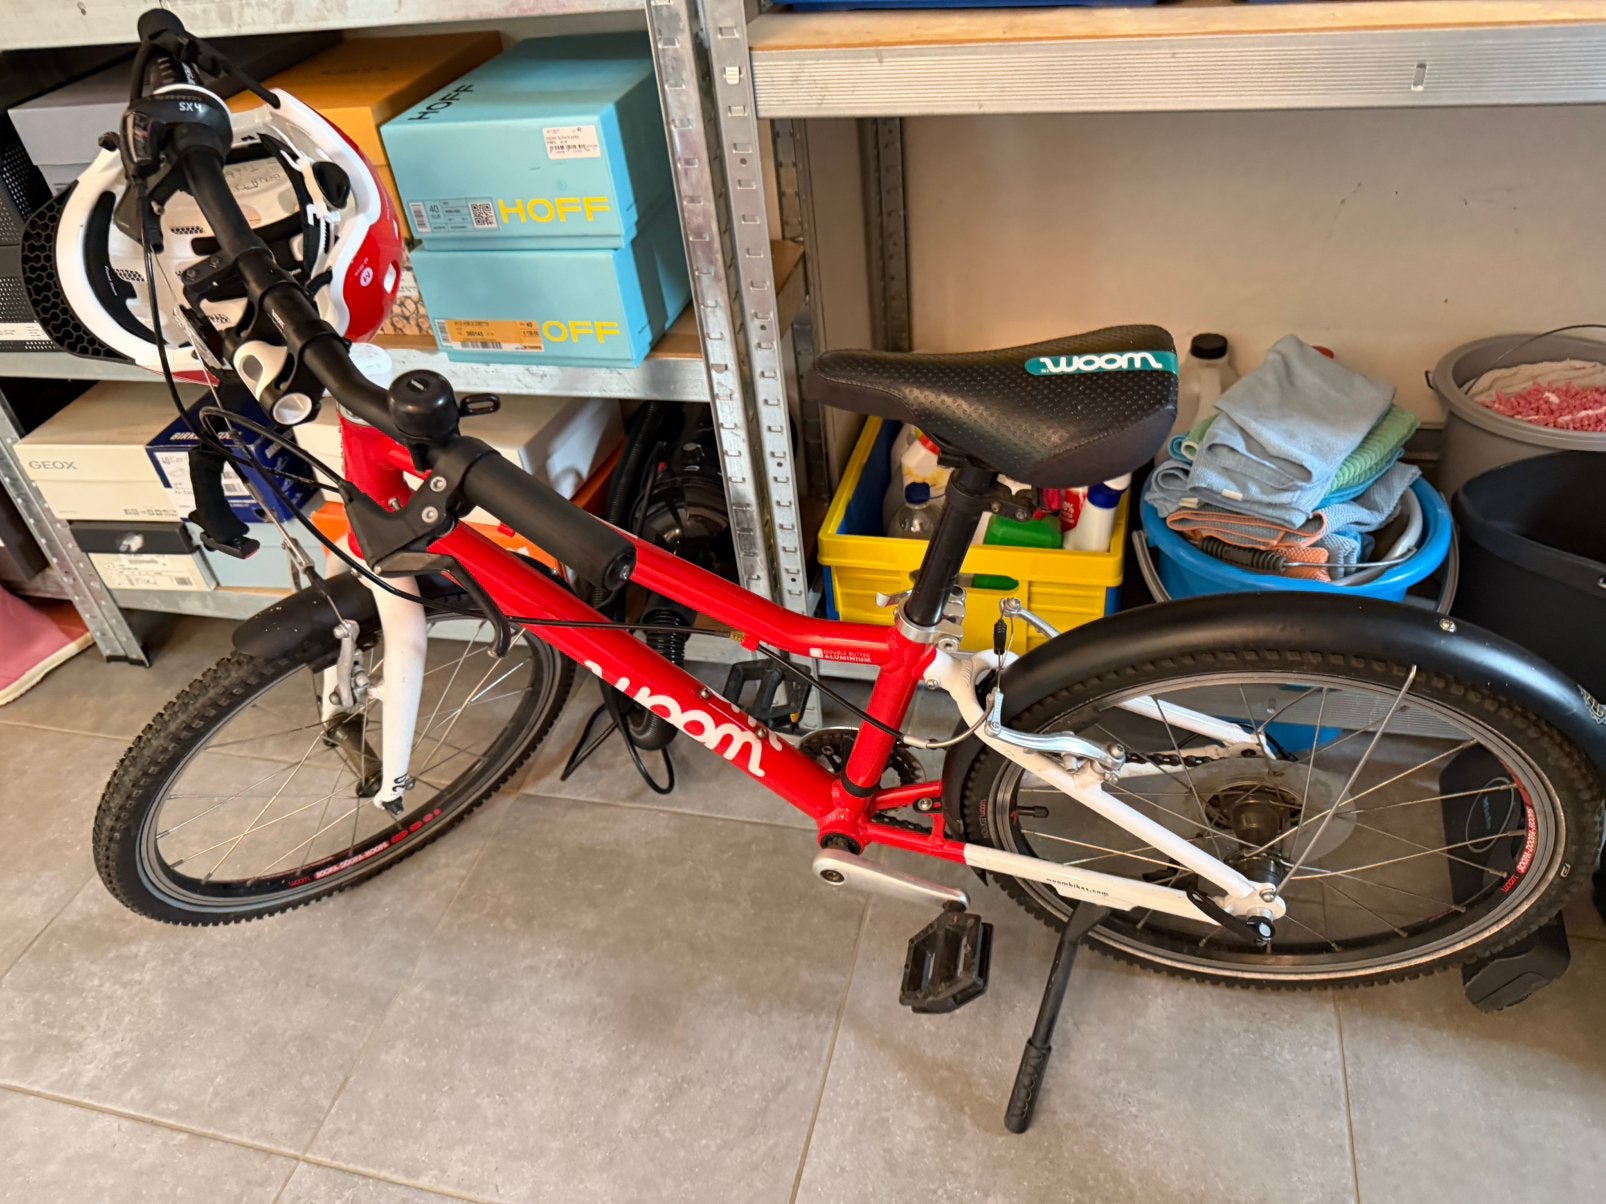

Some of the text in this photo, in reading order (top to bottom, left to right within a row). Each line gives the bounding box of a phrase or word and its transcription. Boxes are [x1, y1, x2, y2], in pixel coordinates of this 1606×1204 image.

[407, 84, 474, 121] HOFF
[498, 196, 611, 224] HOFF
[542, 320, 621, 343] OFF
[1039, 351, 1163, 373] woom
[28, 460, 78, 470] GEOX
[824, 655, 872, 663] ALUMINIUM
[1046, 878, 1109, 897] woombikes.com
